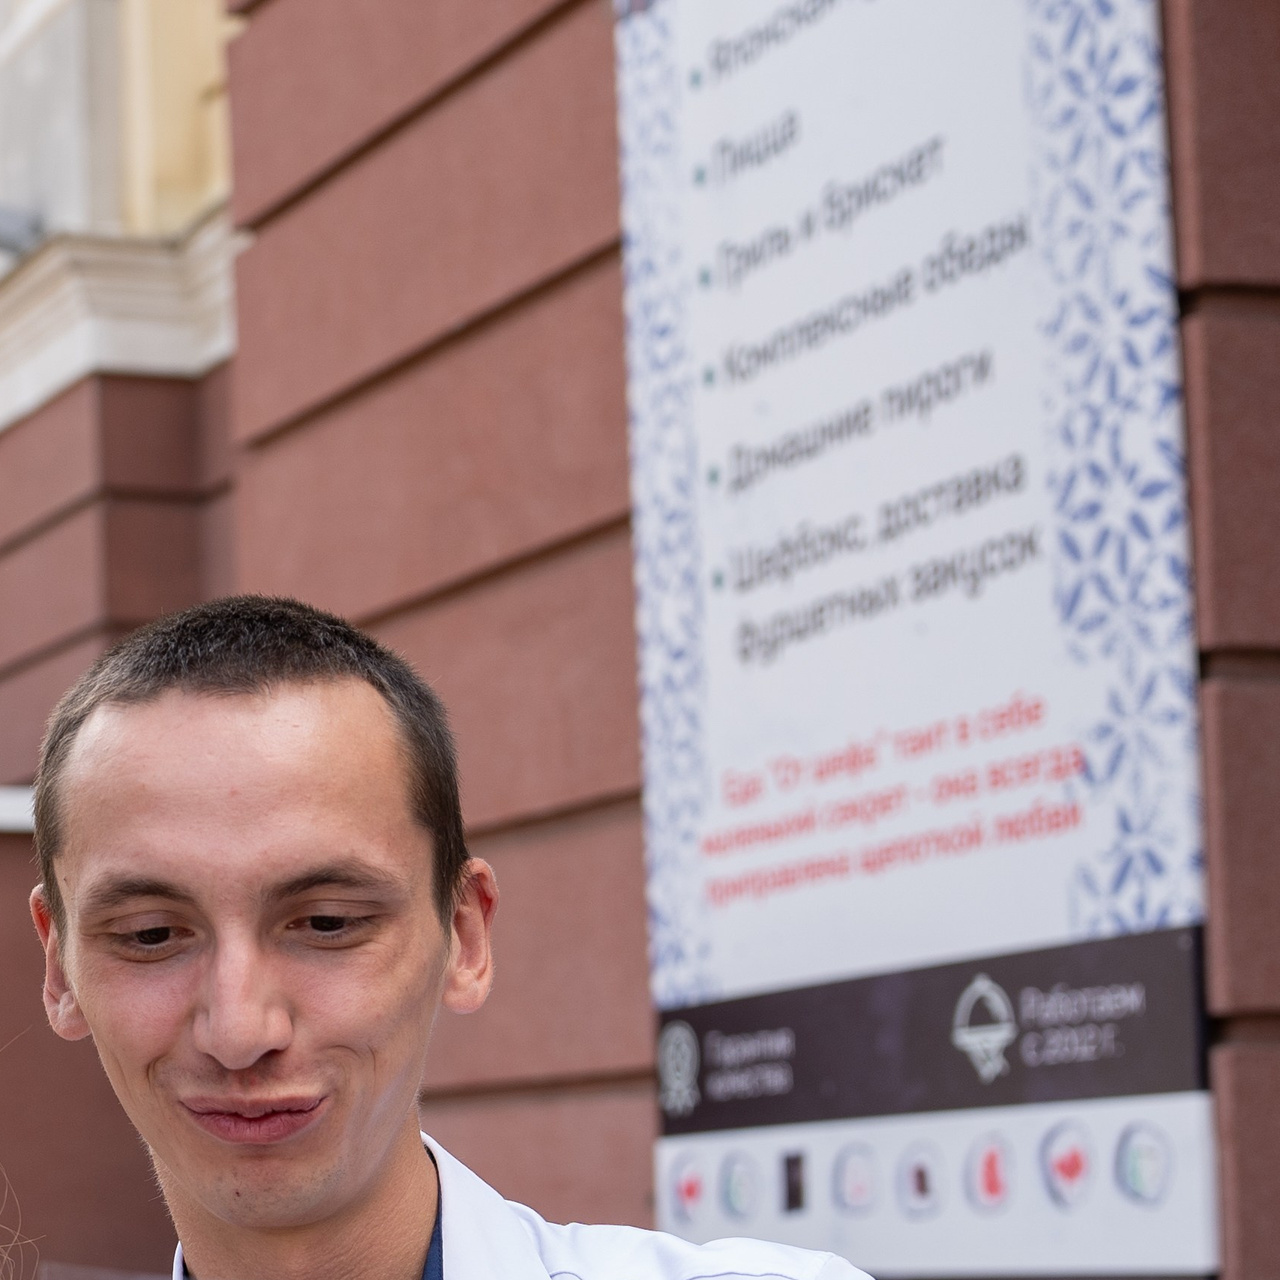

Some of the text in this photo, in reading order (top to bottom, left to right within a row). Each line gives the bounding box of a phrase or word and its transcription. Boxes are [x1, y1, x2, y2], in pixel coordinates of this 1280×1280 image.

[721, 221, 792, 288] Гриль
[800, 208, 816, 239] и
[725, 214, 1030, 384] Комплексные обеды
[728, 348, 993, 494] Домашние пироги
[877, 453, 1026, 544] доставка
[914, 524, 1044, 602] закусок
